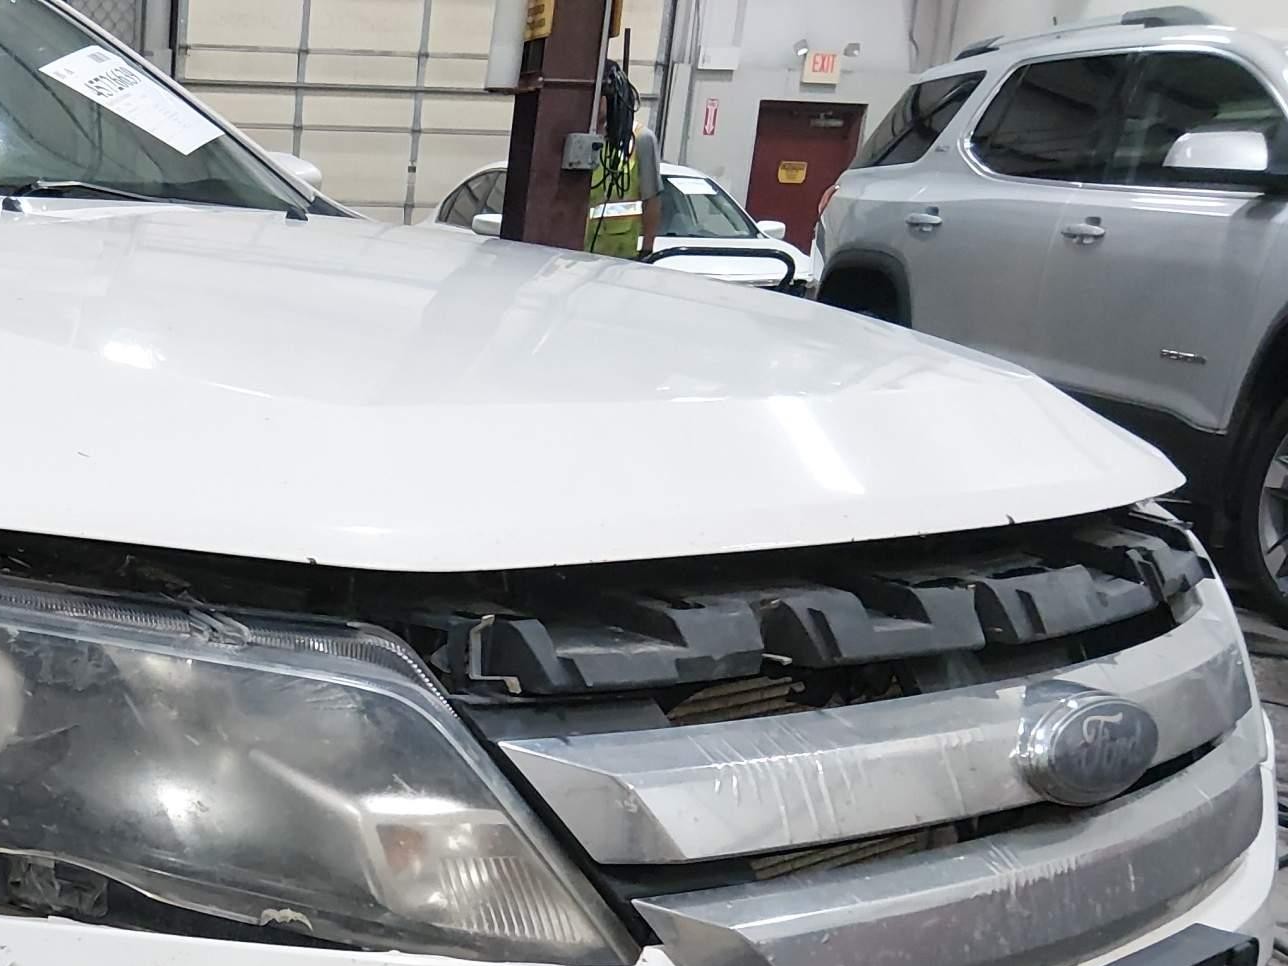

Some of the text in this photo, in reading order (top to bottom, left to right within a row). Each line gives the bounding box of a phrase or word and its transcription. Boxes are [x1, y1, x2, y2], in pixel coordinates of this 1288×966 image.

[812, 53, 837, 73] EXIT
[84, 67, 142, 97] 45726639
[1072, 711, 1143, 770] Ford
